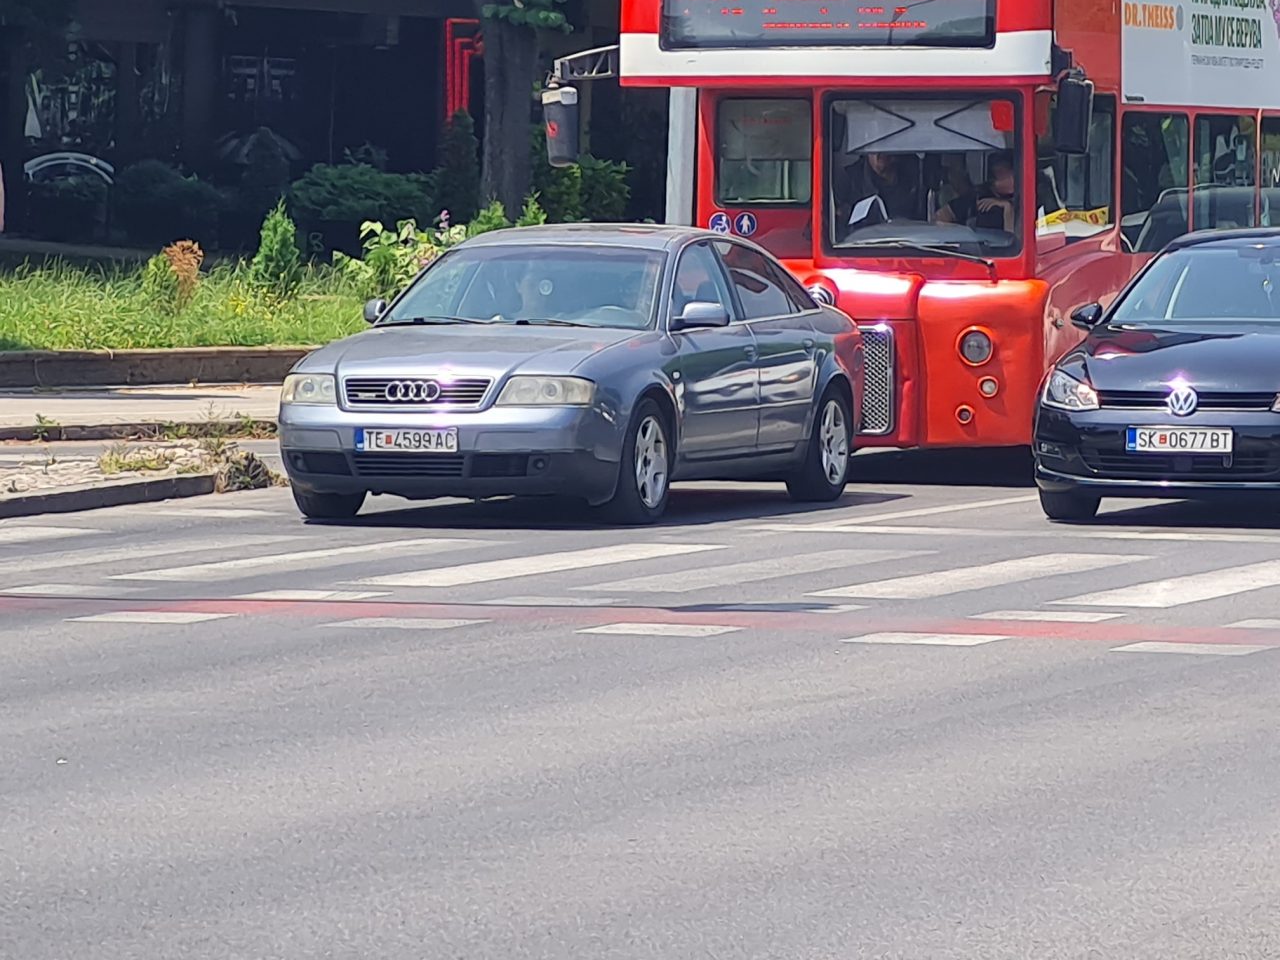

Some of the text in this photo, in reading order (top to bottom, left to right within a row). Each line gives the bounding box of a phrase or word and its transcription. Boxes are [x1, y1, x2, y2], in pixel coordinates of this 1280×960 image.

[366, 431, 384, 448] TE
[394, 431, 431, 449] 4599
[1139, 431, 1230, 449] SK 0677 BT
